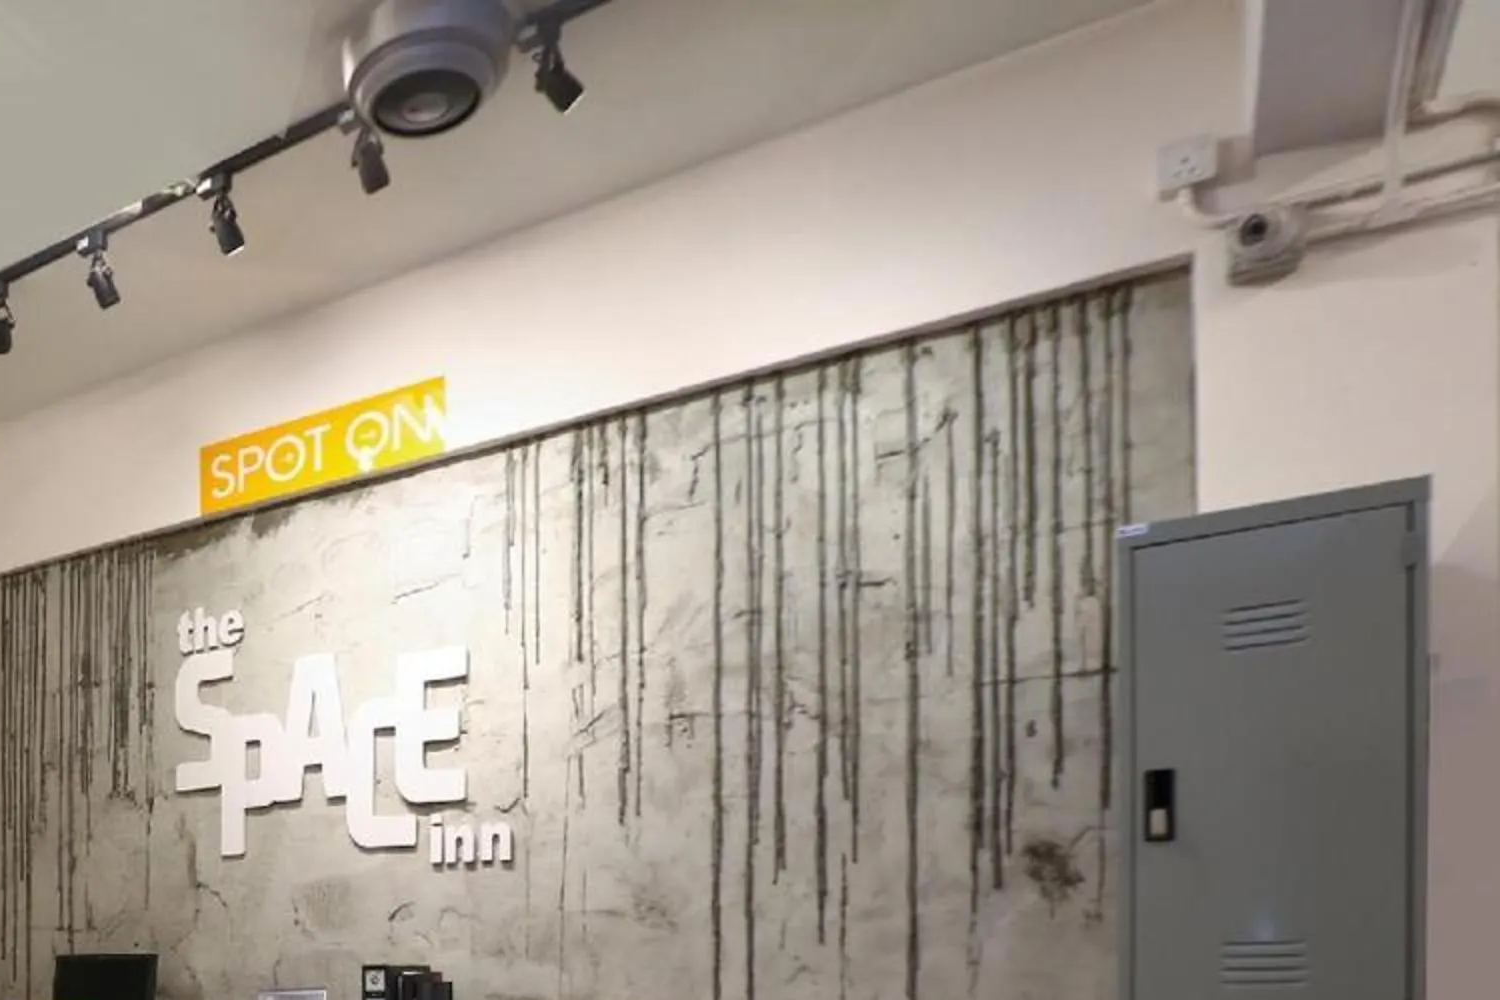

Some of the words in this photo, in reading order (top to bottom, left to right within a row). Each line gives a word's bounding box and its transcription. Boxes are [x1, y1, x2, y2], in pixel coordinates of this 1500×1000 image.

[211, 423, 332, 499] SPOT
[177, 606, 245, 655] the
[429, 813, 515, 868] inn
